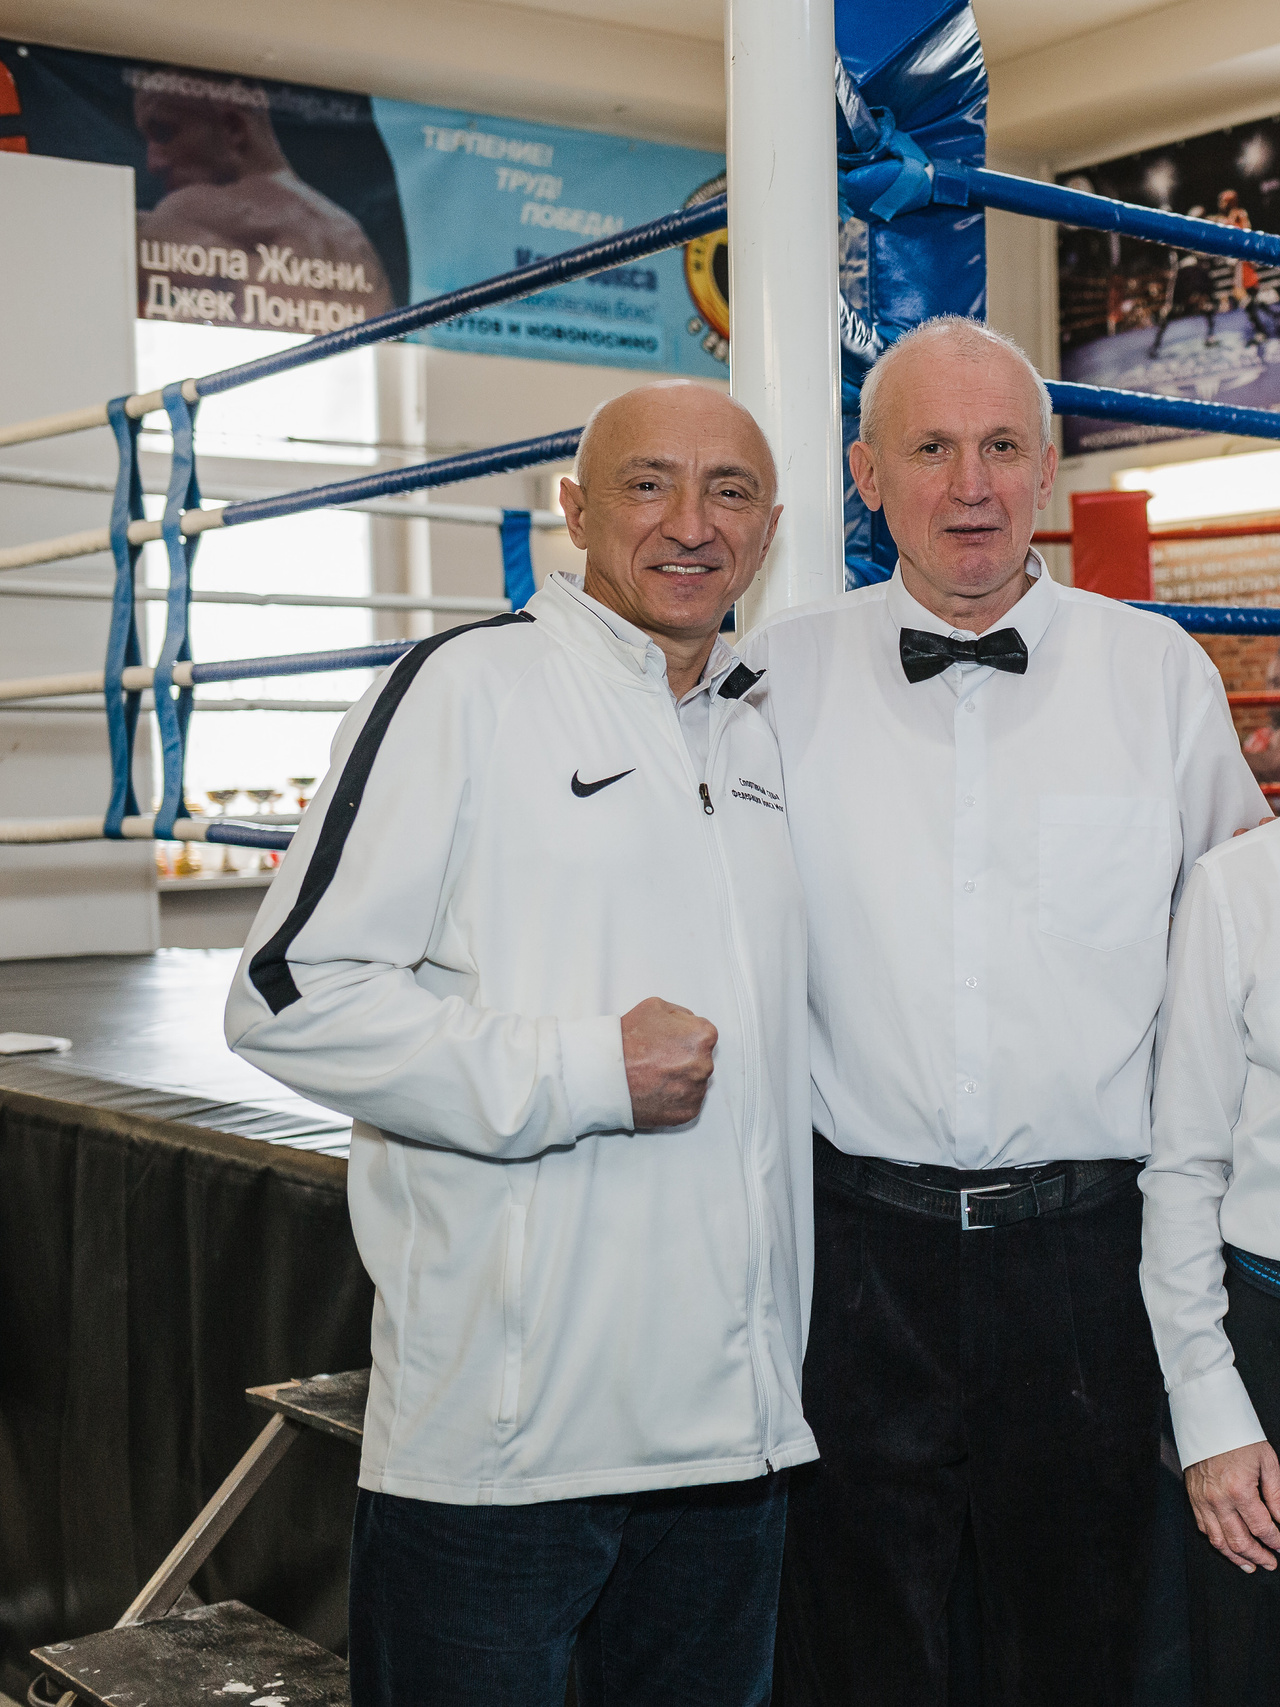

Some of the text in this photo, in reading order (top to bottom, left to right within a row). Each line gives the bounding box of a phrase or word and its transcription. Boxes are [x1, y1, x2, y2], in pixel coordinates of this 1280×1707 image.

[423, 125, 554, 168] ТЕРПЕНИЕ!
[495, 166, 563, 202] ТРУД!
[520, 202, 625, 237] ПОБЕДА!
[140, 239, 374, 294] школа Жизни.
[146, 274, 366, 334] Джек Лондон
